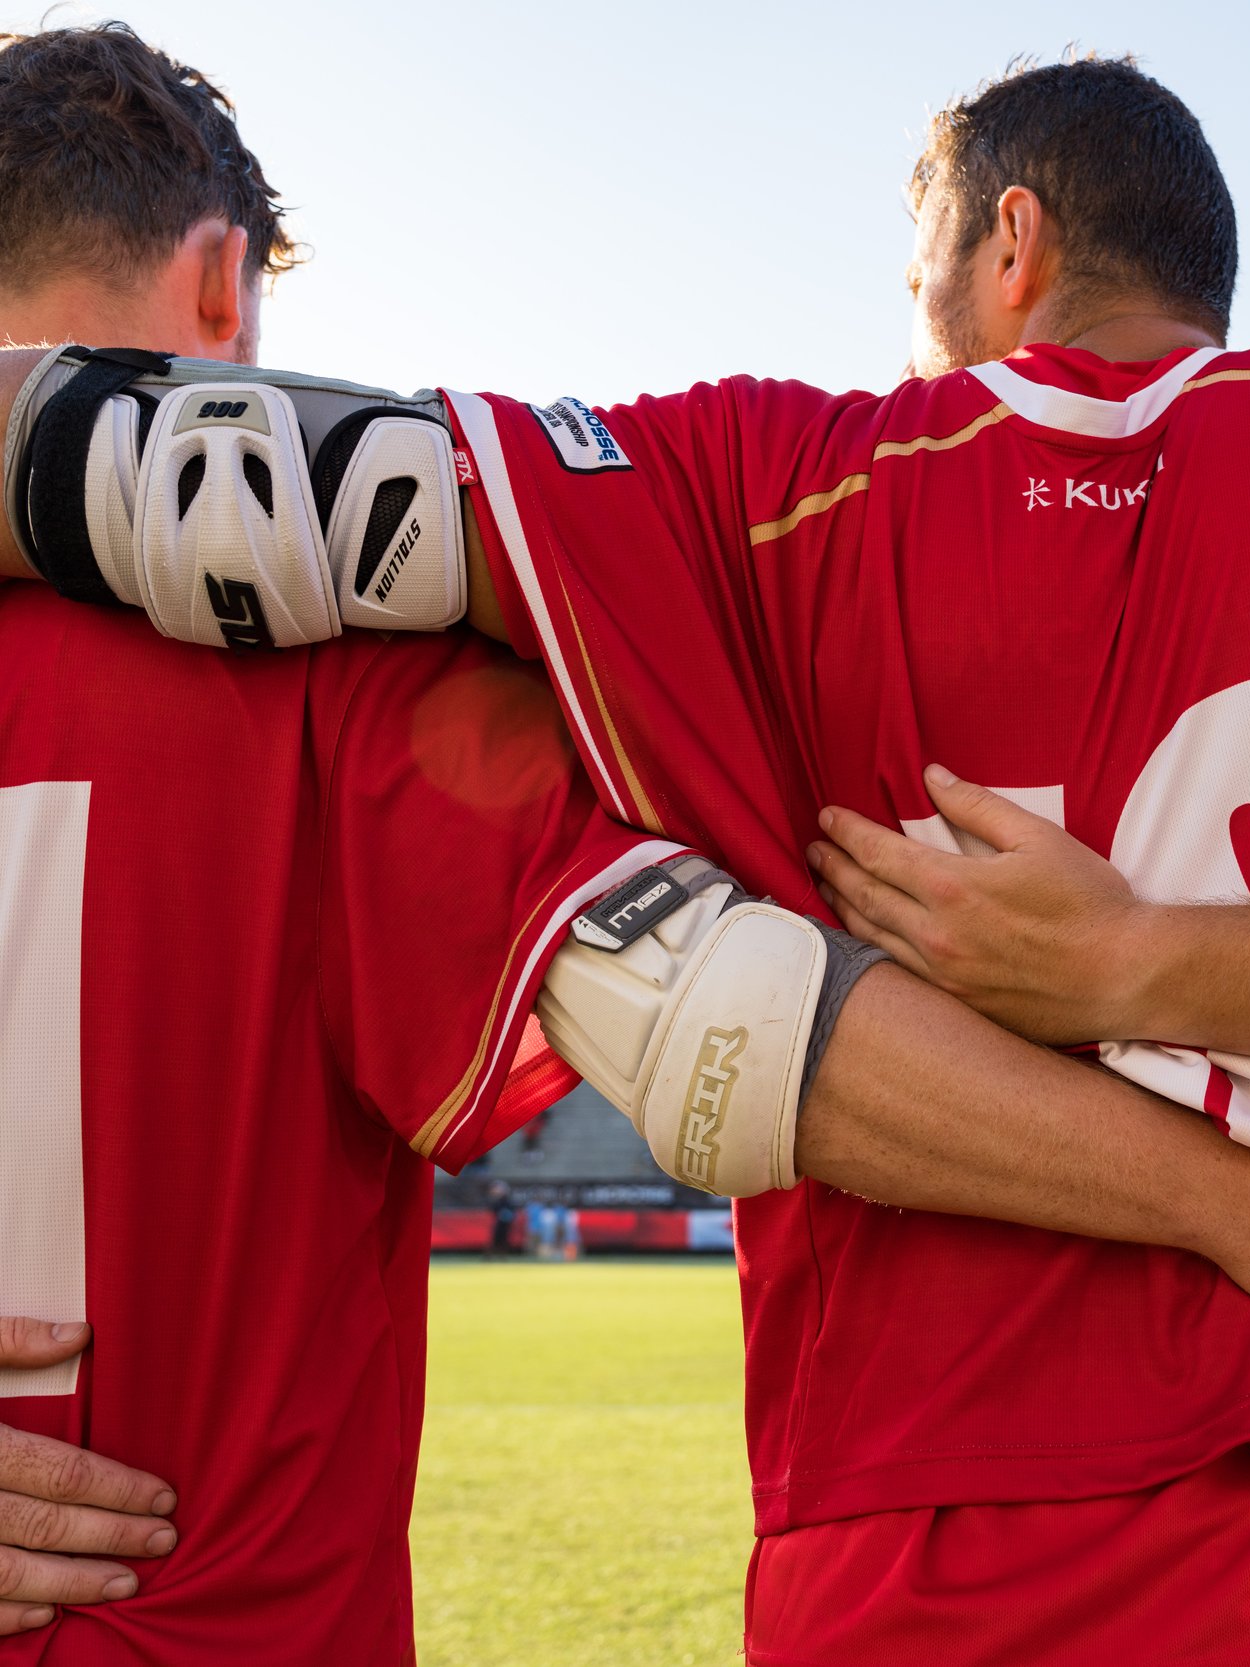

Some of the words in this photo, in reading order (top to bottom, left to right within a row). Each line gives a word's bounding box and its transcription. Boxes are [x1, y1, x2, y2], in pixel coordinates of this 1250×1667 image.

[197, 400, 249, 418] 900
[453, 450, 475, 483] STX
[374, 518, 422, 603] STALLION
[677, 1030, 745, 1190] ERIK
